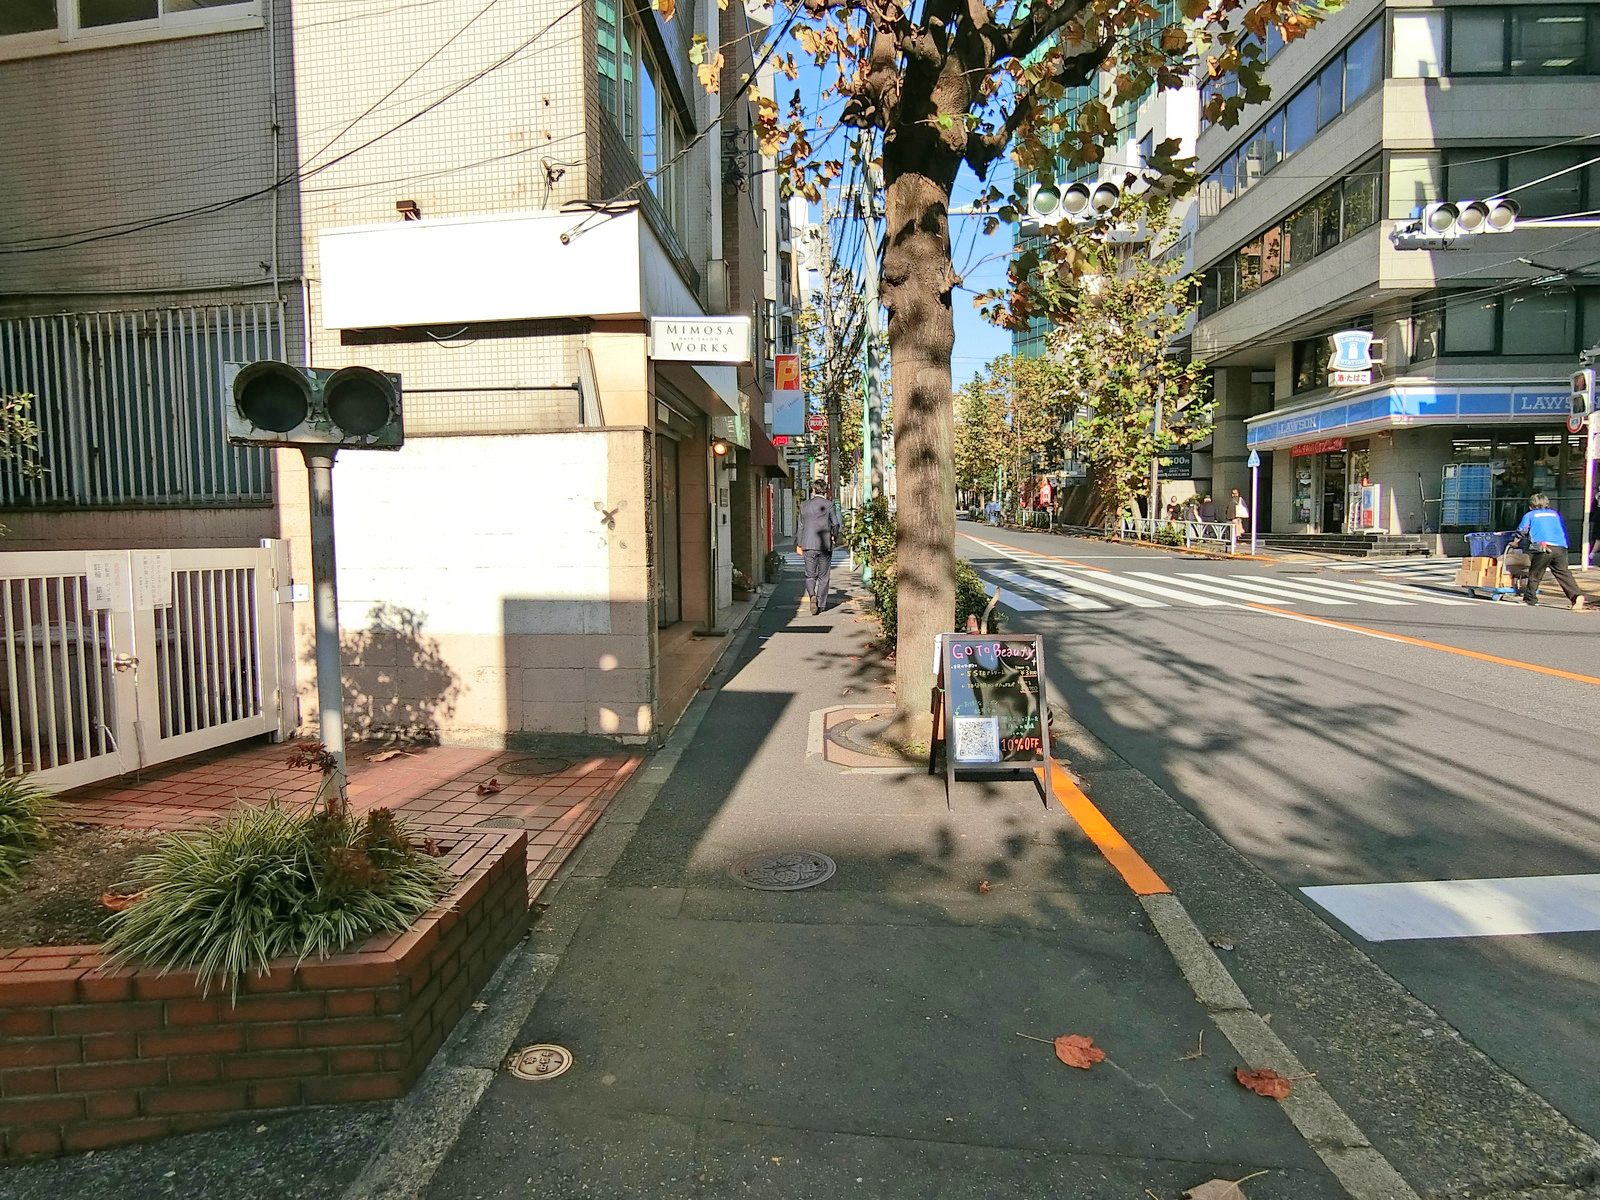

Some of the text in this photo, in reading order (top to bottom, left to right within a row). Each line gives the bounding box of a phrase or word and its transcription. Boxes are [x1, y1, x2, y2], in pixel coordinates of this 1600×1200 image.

[666, 324, 734, 336] MIMOSA
[671, 342, 729, 353] WORKS
[1280, 416, 1317, 434] LAWSON
[95, 586, 104, 601] 禁止
[993, 643, 1036, 660] Beauty
